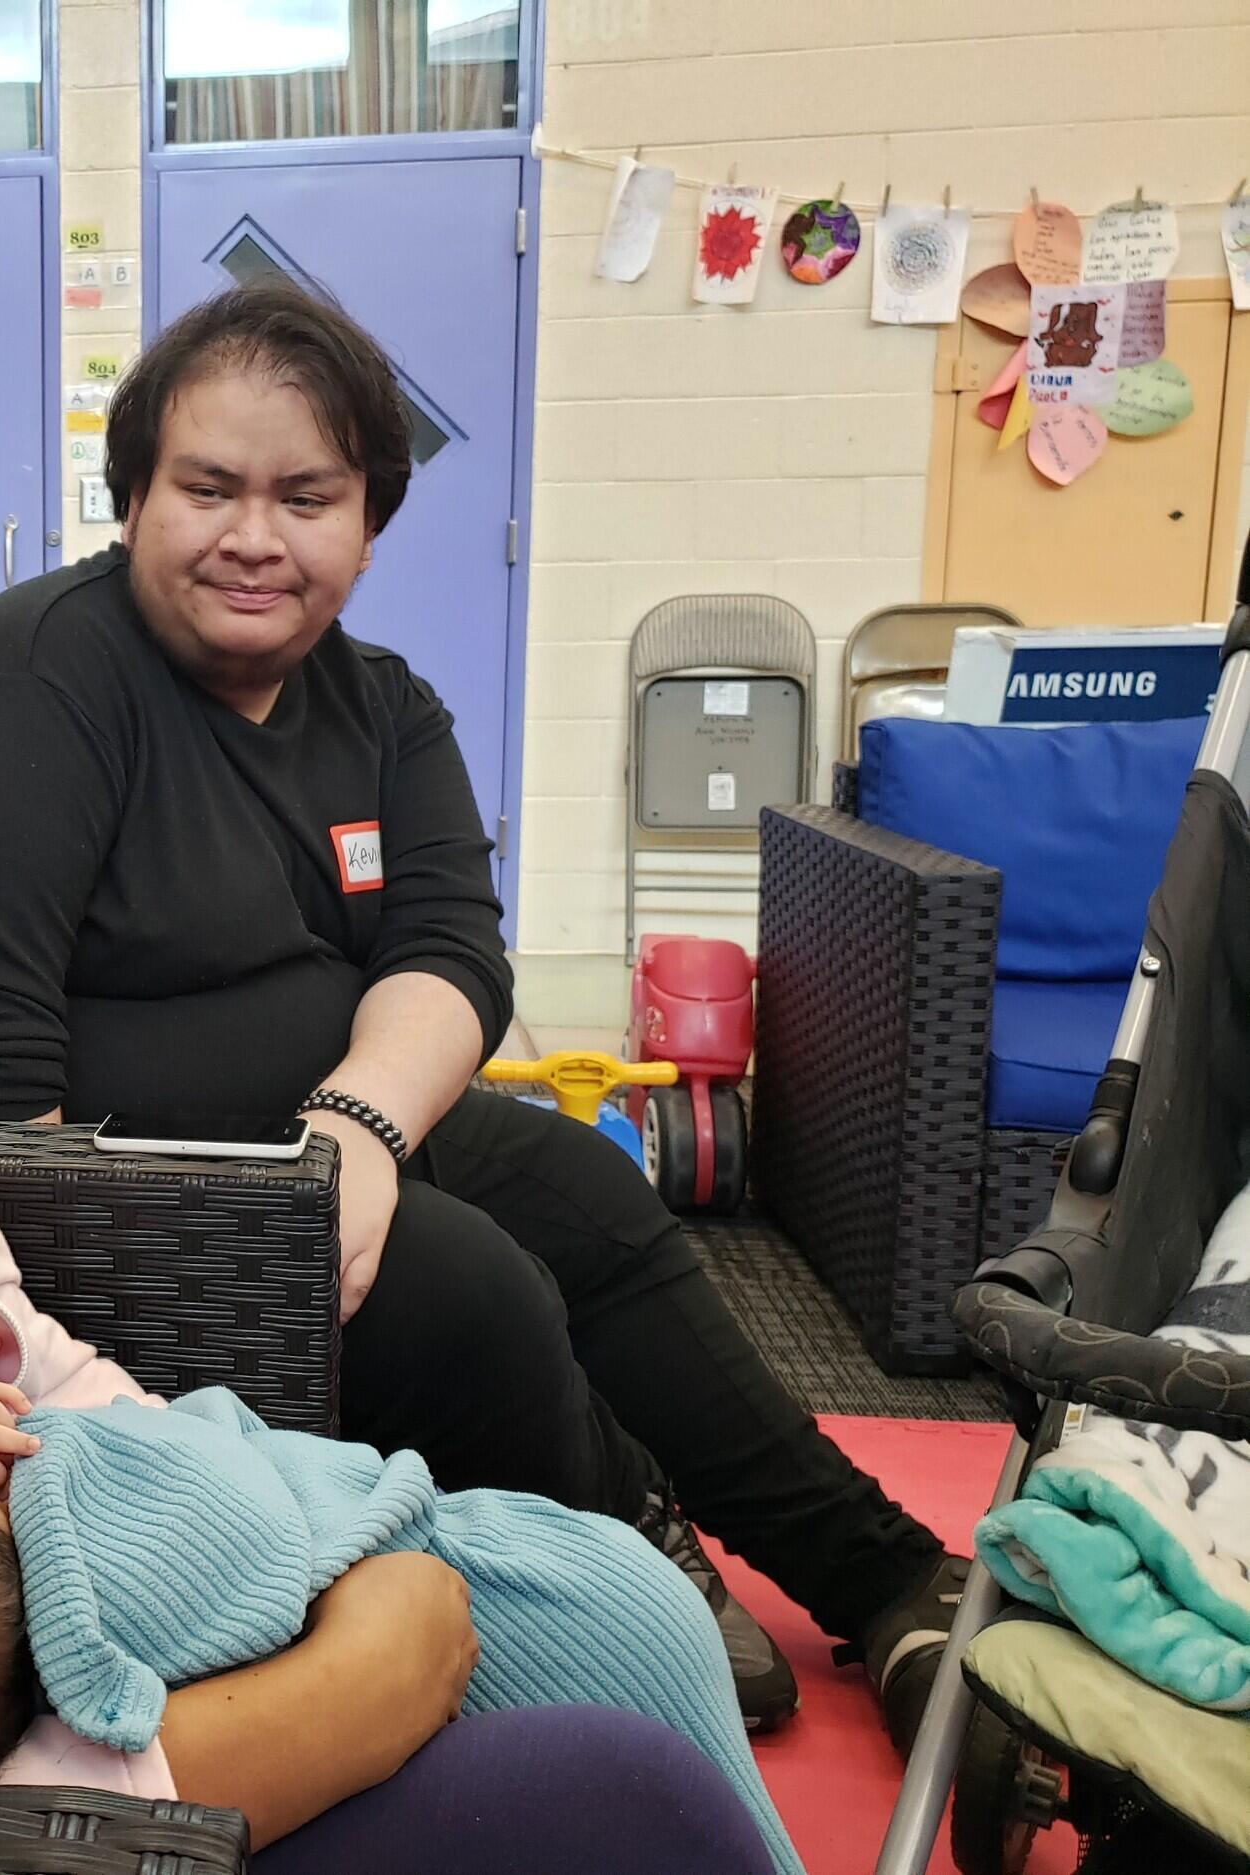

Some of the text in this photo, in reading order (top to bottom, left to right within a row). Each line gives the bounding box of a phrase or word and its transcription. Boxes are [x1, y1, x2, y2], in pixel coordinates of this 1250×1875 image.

[70, 231, 100, 245] 803
[116, 266, 127, 282] B
[88, 362, 117, 376] 804
